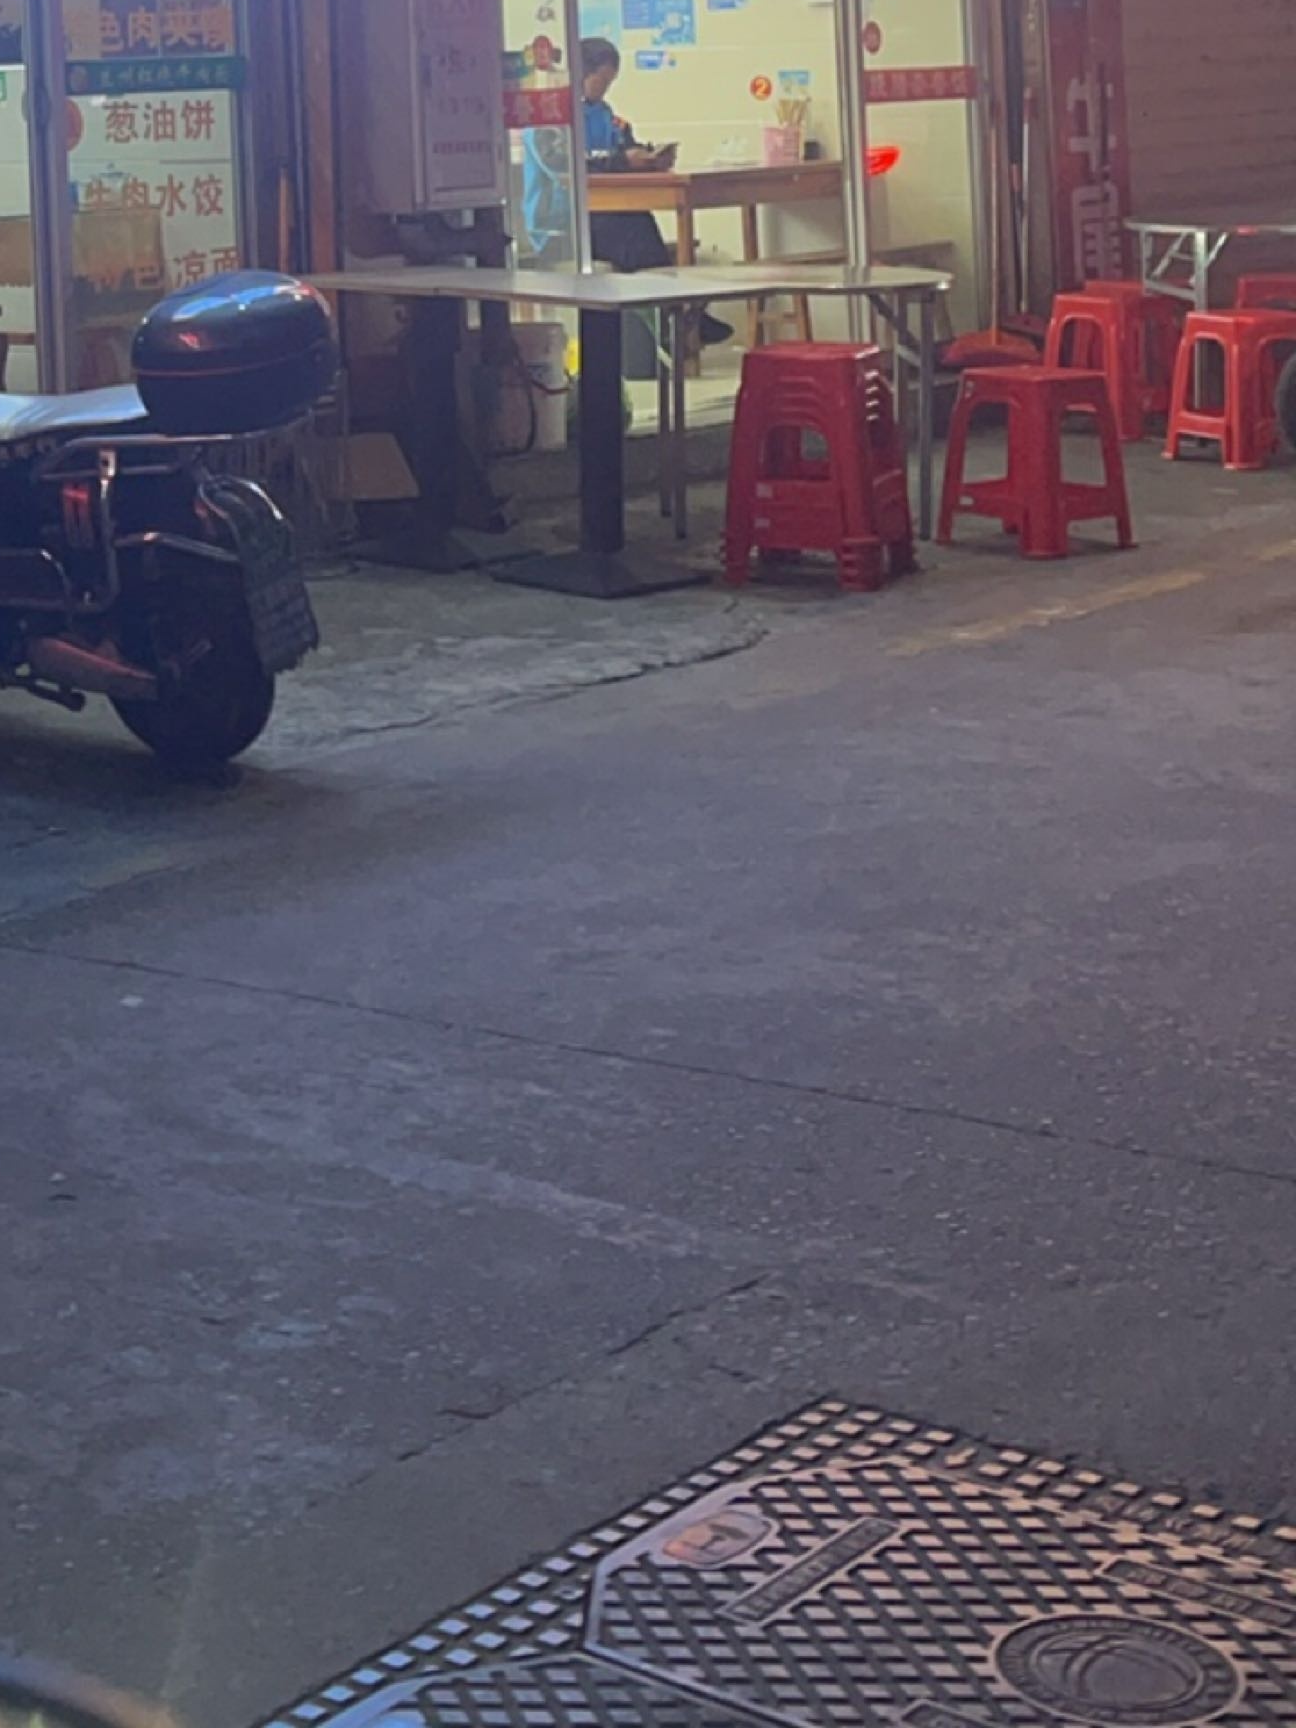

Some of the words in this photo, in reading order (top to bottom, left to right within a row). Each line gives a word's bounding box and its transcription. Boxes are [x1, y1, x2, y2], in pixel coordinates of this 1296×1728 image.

[755, 76, 770, 95] 2
[103, 99, 216, 144] 葱油饼
[84, 173, 225, 218] 牛肉水饺
